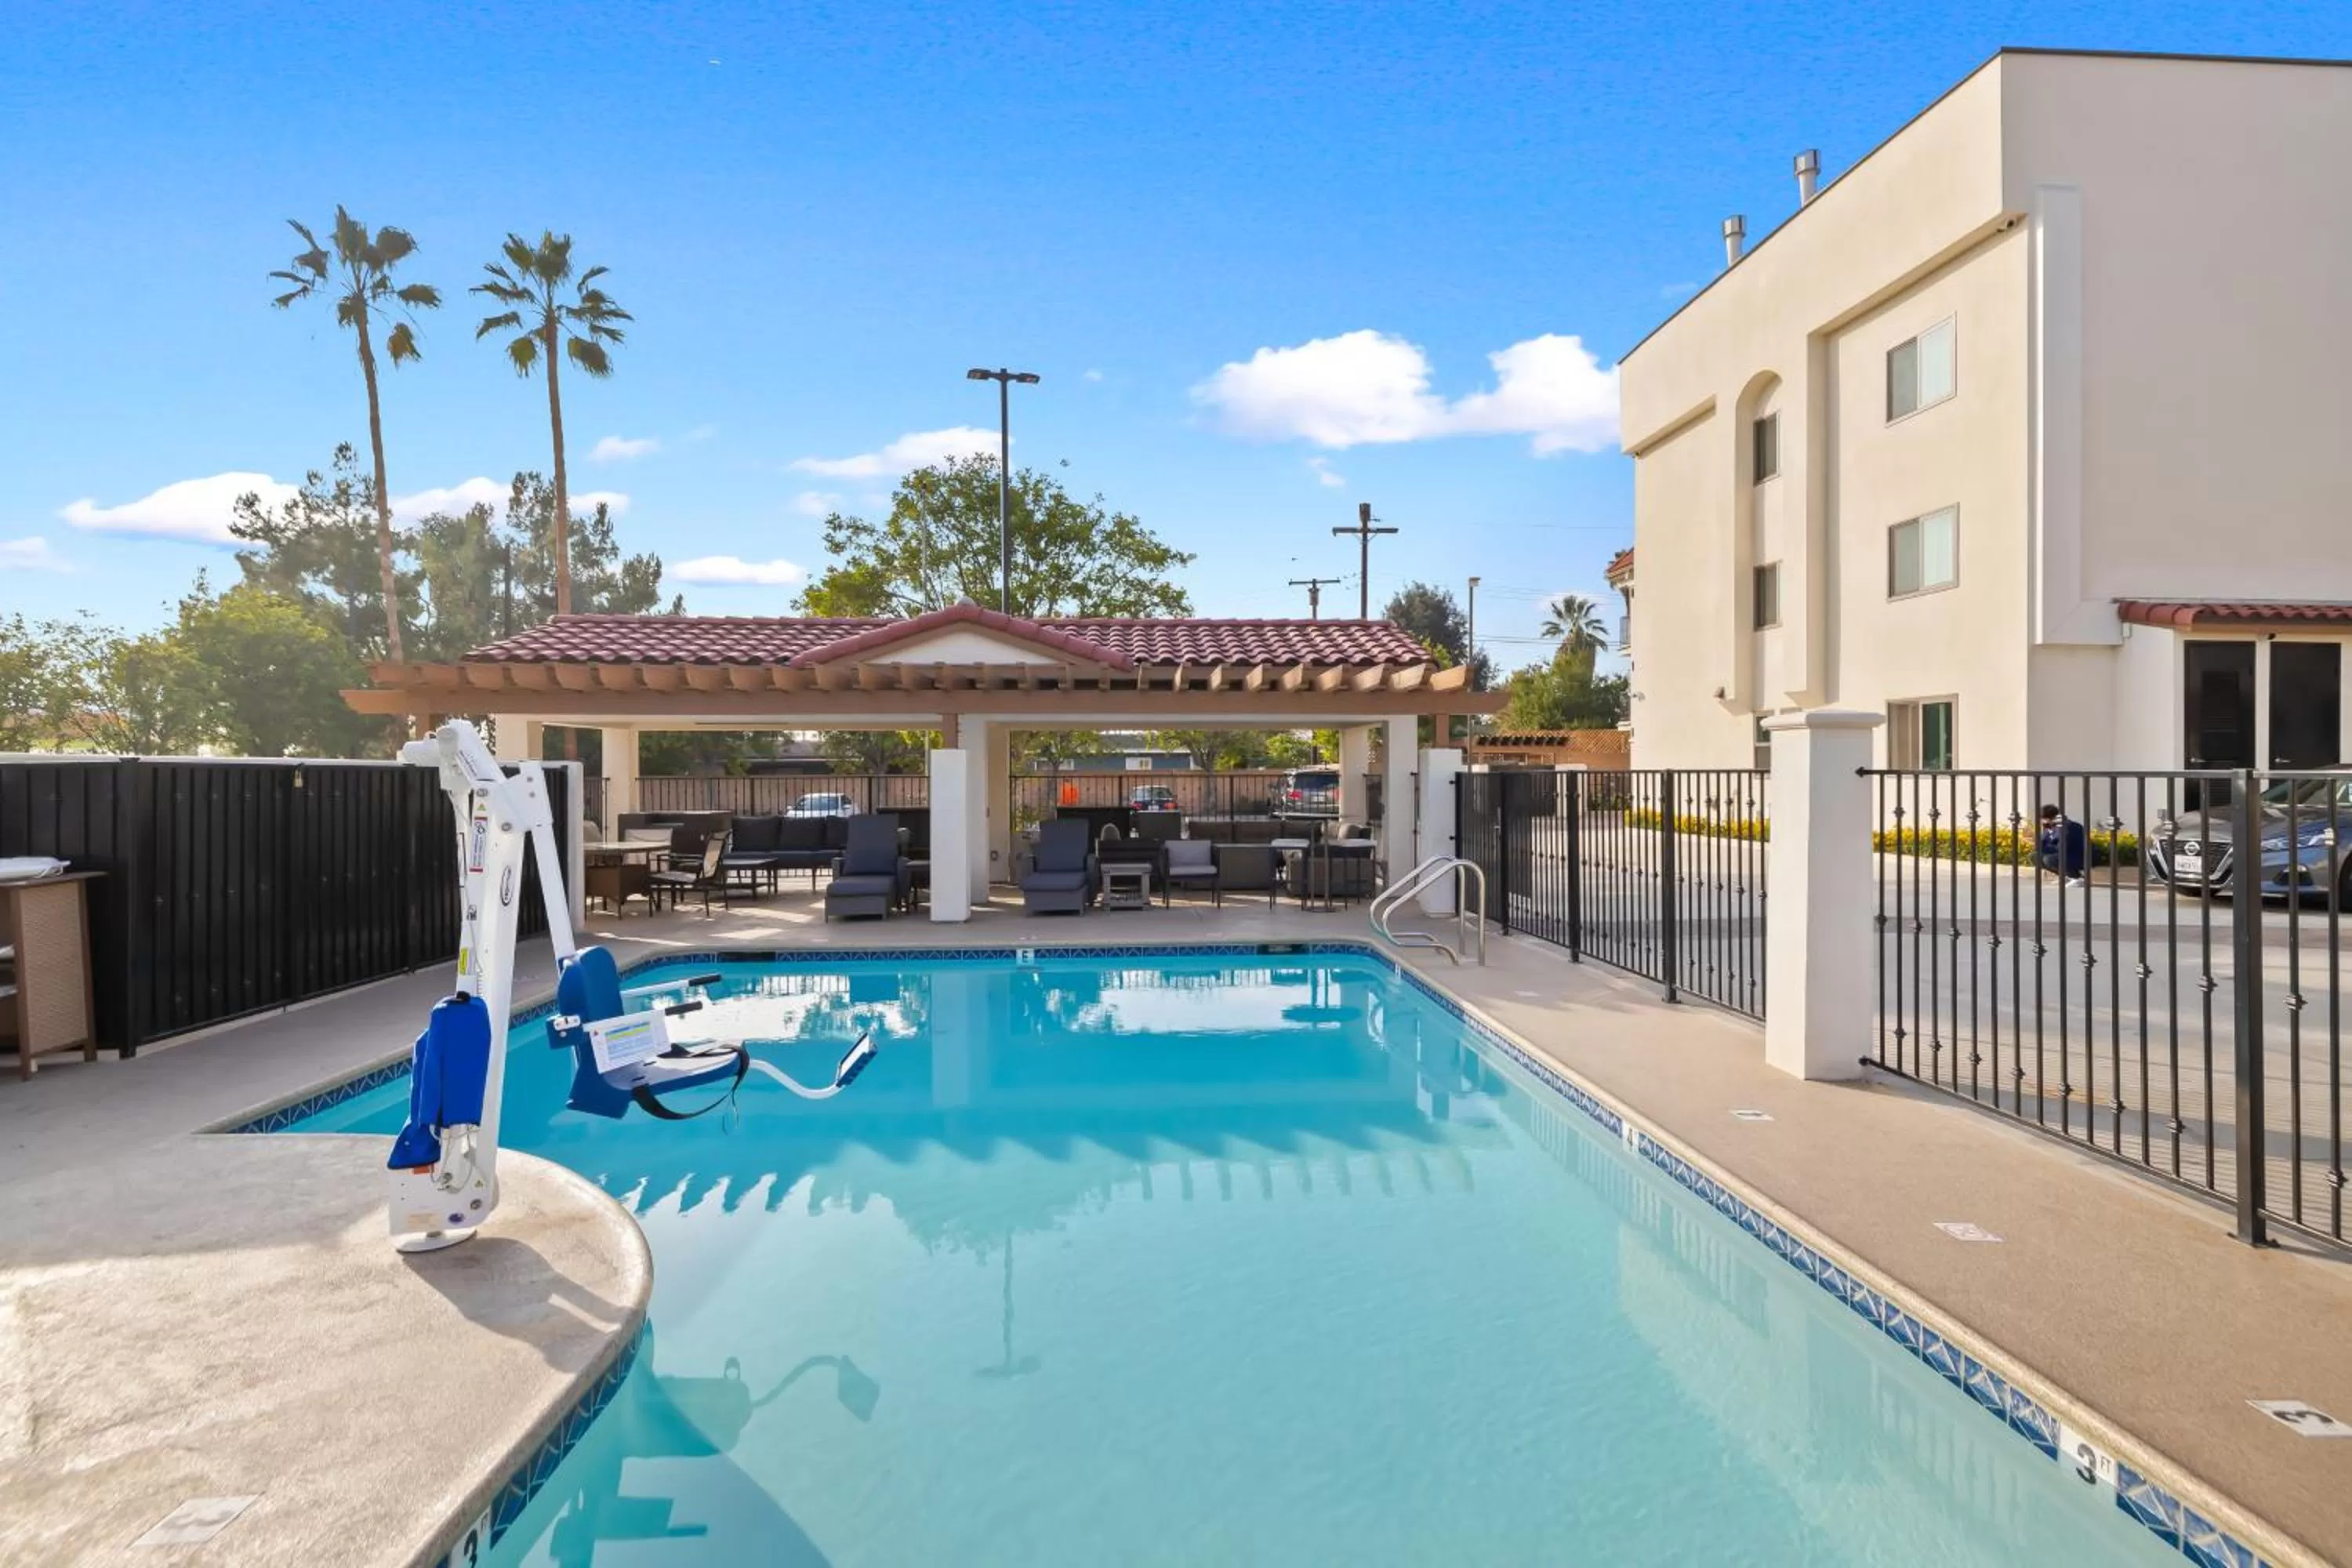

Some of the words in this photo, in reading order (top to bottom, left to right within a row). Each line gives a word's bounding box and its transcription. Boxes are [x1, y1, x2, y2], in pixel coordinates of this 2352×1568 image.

[2076, 1443, 2097, 1485] 3
[2100, 1456, 2111, 1474] FT
[463, 1528, 477, 1568] 3
